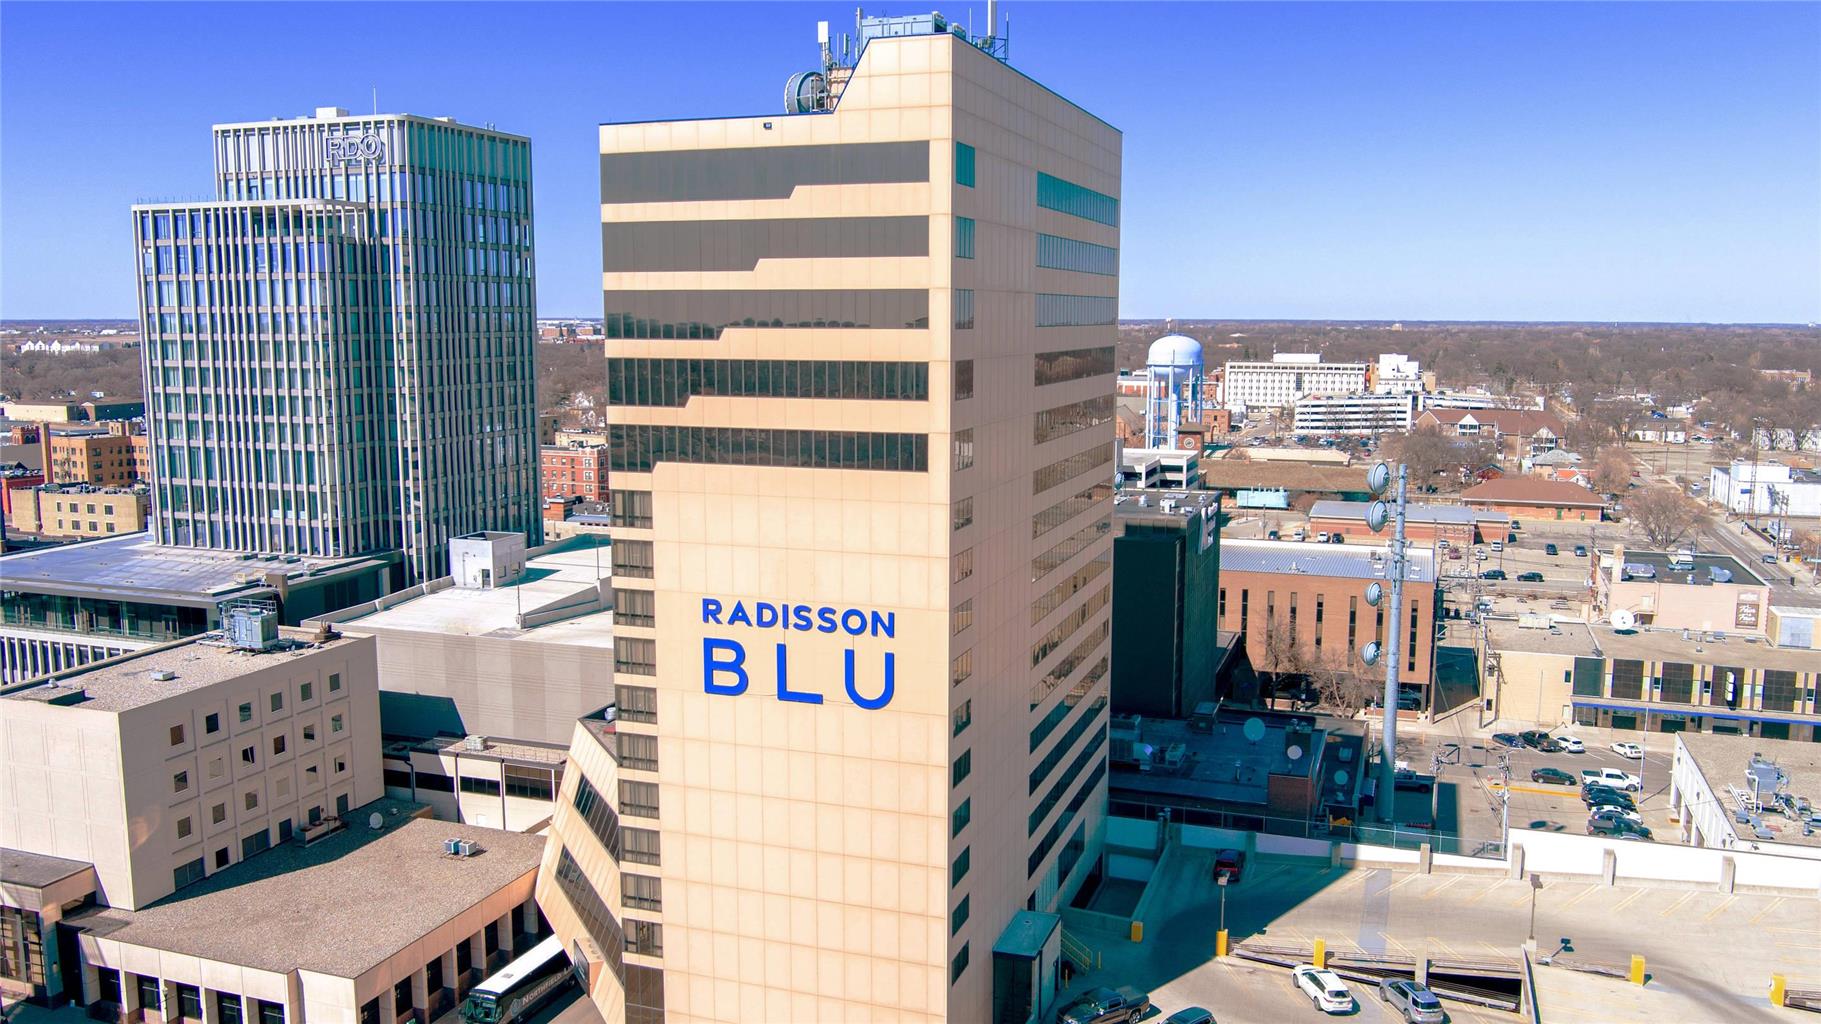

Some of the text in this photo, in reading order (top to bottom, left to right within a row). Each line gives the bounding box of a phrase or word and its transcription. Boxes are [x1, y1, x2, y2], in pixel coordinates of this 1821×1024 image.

[325, 134, 382, 161] RDO
[702, 598, 895, 638] RADISSON
[703, 637, 895, 710] BLU
[521, 973, 562, 1006] NORTHFIELD
